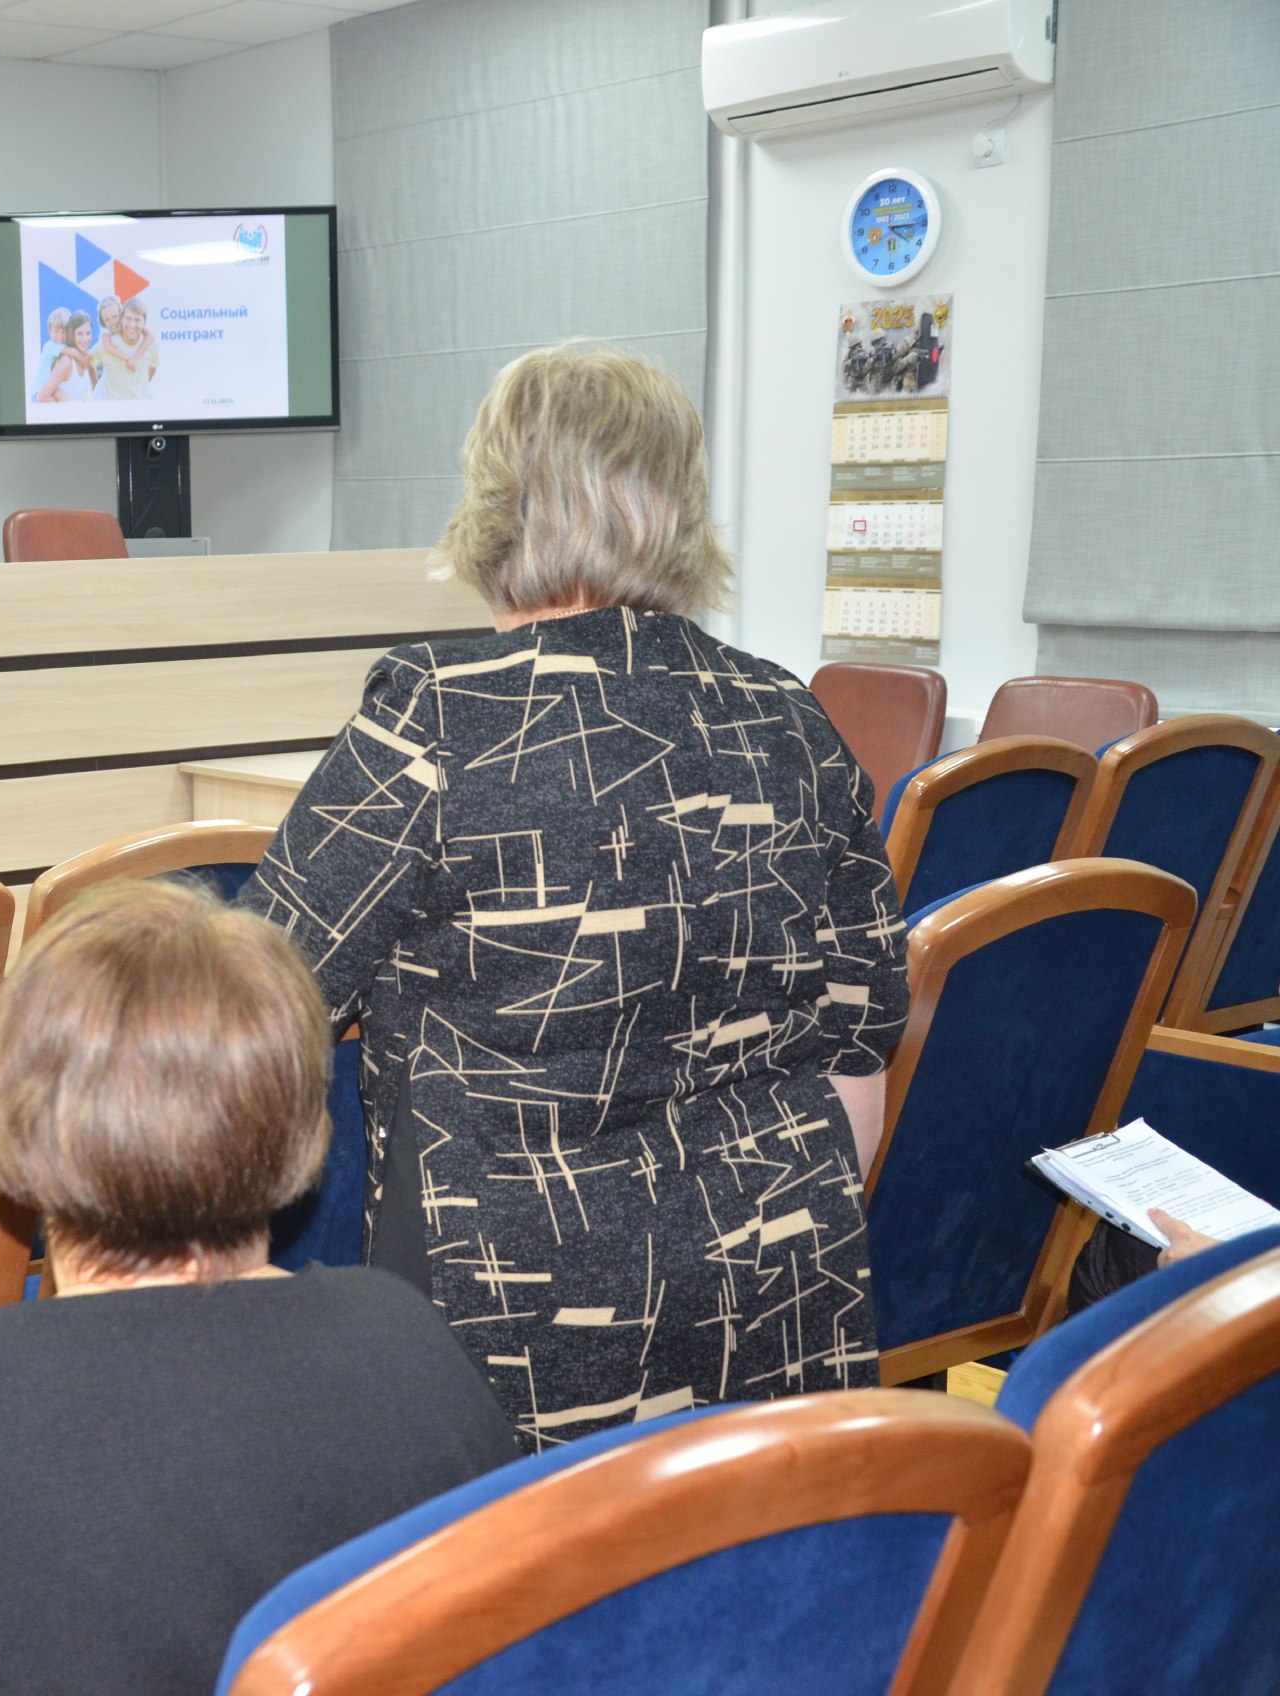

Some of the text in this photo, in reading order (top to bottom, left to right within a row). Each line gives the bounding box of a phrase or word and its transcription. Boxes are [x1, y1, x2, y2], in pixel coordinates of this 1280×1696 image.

[888, 184, 898, 193] 12
[880, 198, 890, 206] 30
[917, 200, 924, 209] 2
[860, 208, 870, 216] 10
[857, 228, 864, 236] 9
[916, 239, 922, 247] 4
[872, 258, 879, 267] 7
[904, 254, 911, 263] 5
[160, 305, 248, 320] Социальный
[870, 304, 915, 329] 2025
[161, 329, 224, 342] контракт
